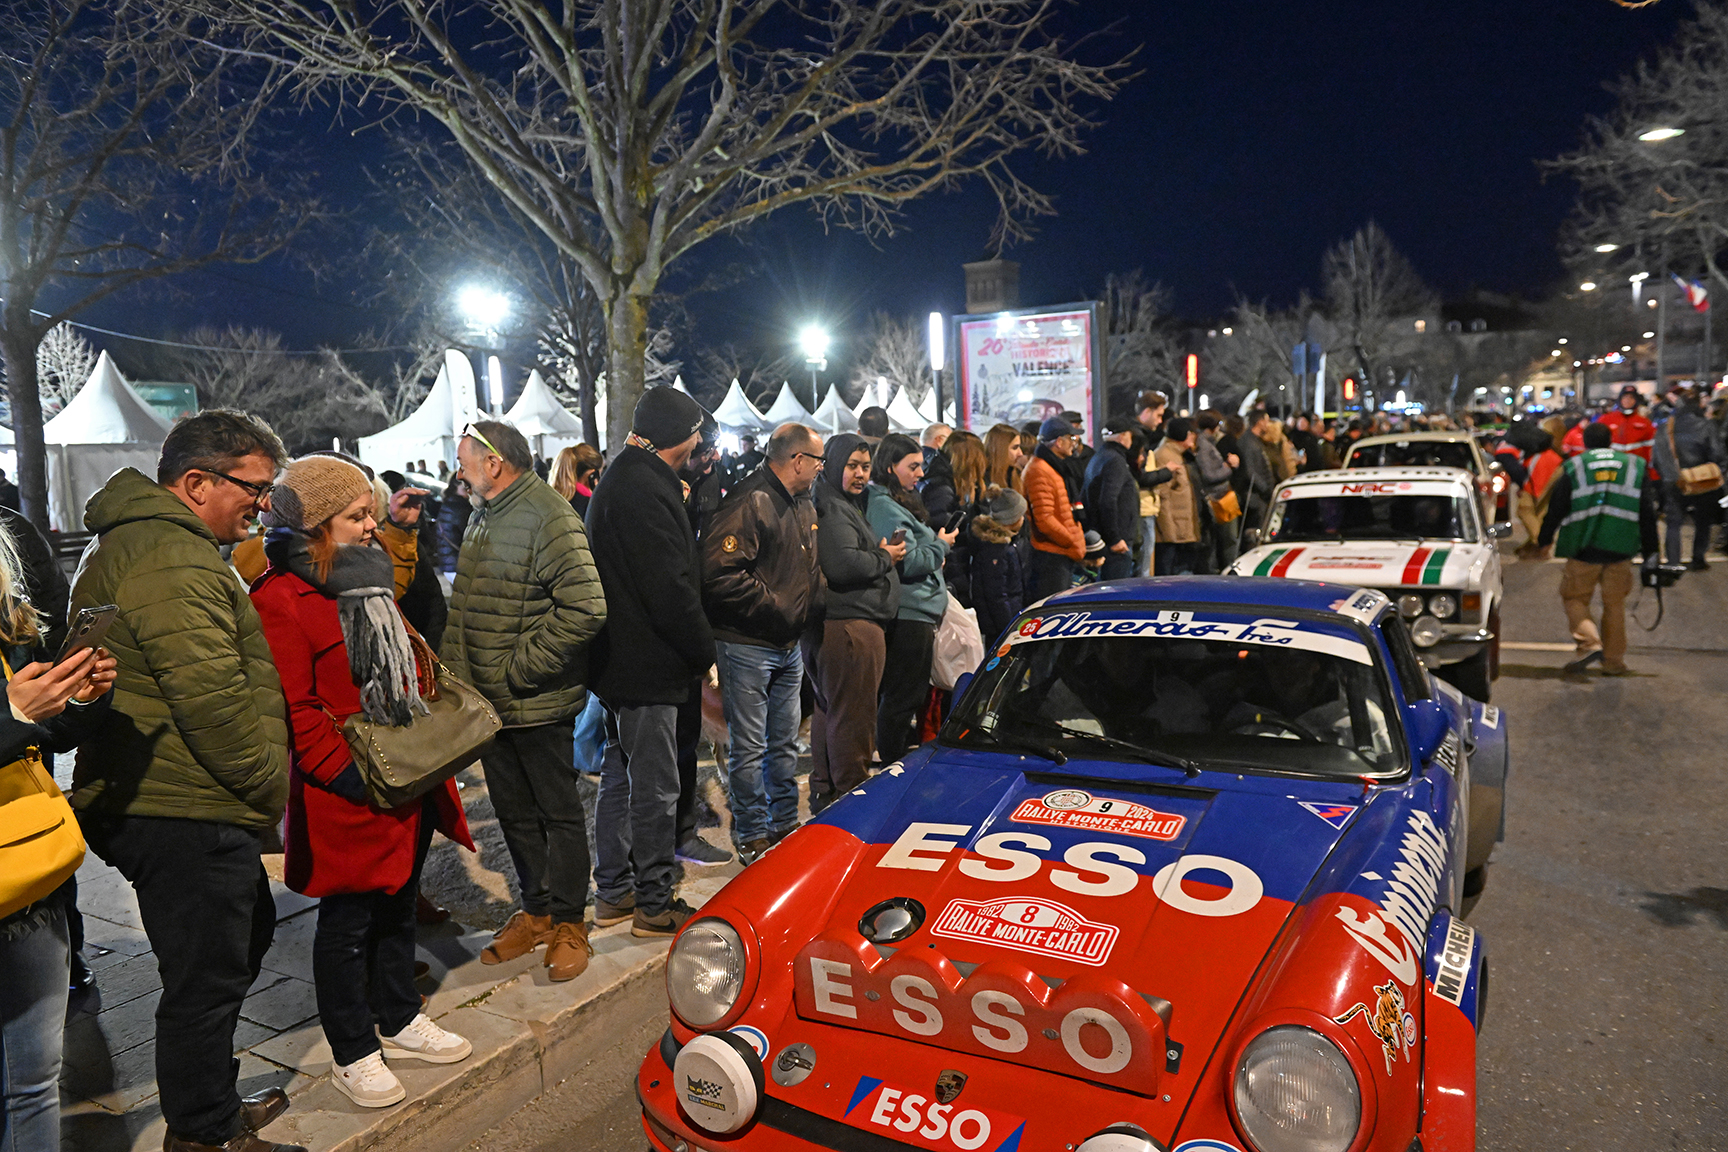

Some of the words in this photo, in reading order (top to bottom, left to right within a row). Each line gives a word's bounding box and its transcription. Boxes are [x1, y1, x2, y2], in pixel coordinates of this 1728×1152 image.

[1022, 622, 1038, 634] 25
[1170, 611, 1181, 622] 9
[1017, 802, 1067, 821] RALLYE
[1068, 813, 1178, 836] MONTE-CARLO
[1050, 819, 1131, 833] HISTORIQUE
[1098, 801, 1114, 814] 9
[1125, 805, 1155, 820] 2024
[875, 822, 1264, 917] ESSO
[942, 904, 994, 936] RALLYE
[991, 922, 1106, 957] MONTE-CARLO
[976, 904, 1006, 919] 1982
[1020, 905, 1040, 924] 8
[1054, 914, 1080, 933] 1982
[810, 957, 1132, 1073] ESSO
[870, 1086, 991, 1150] ESSO
